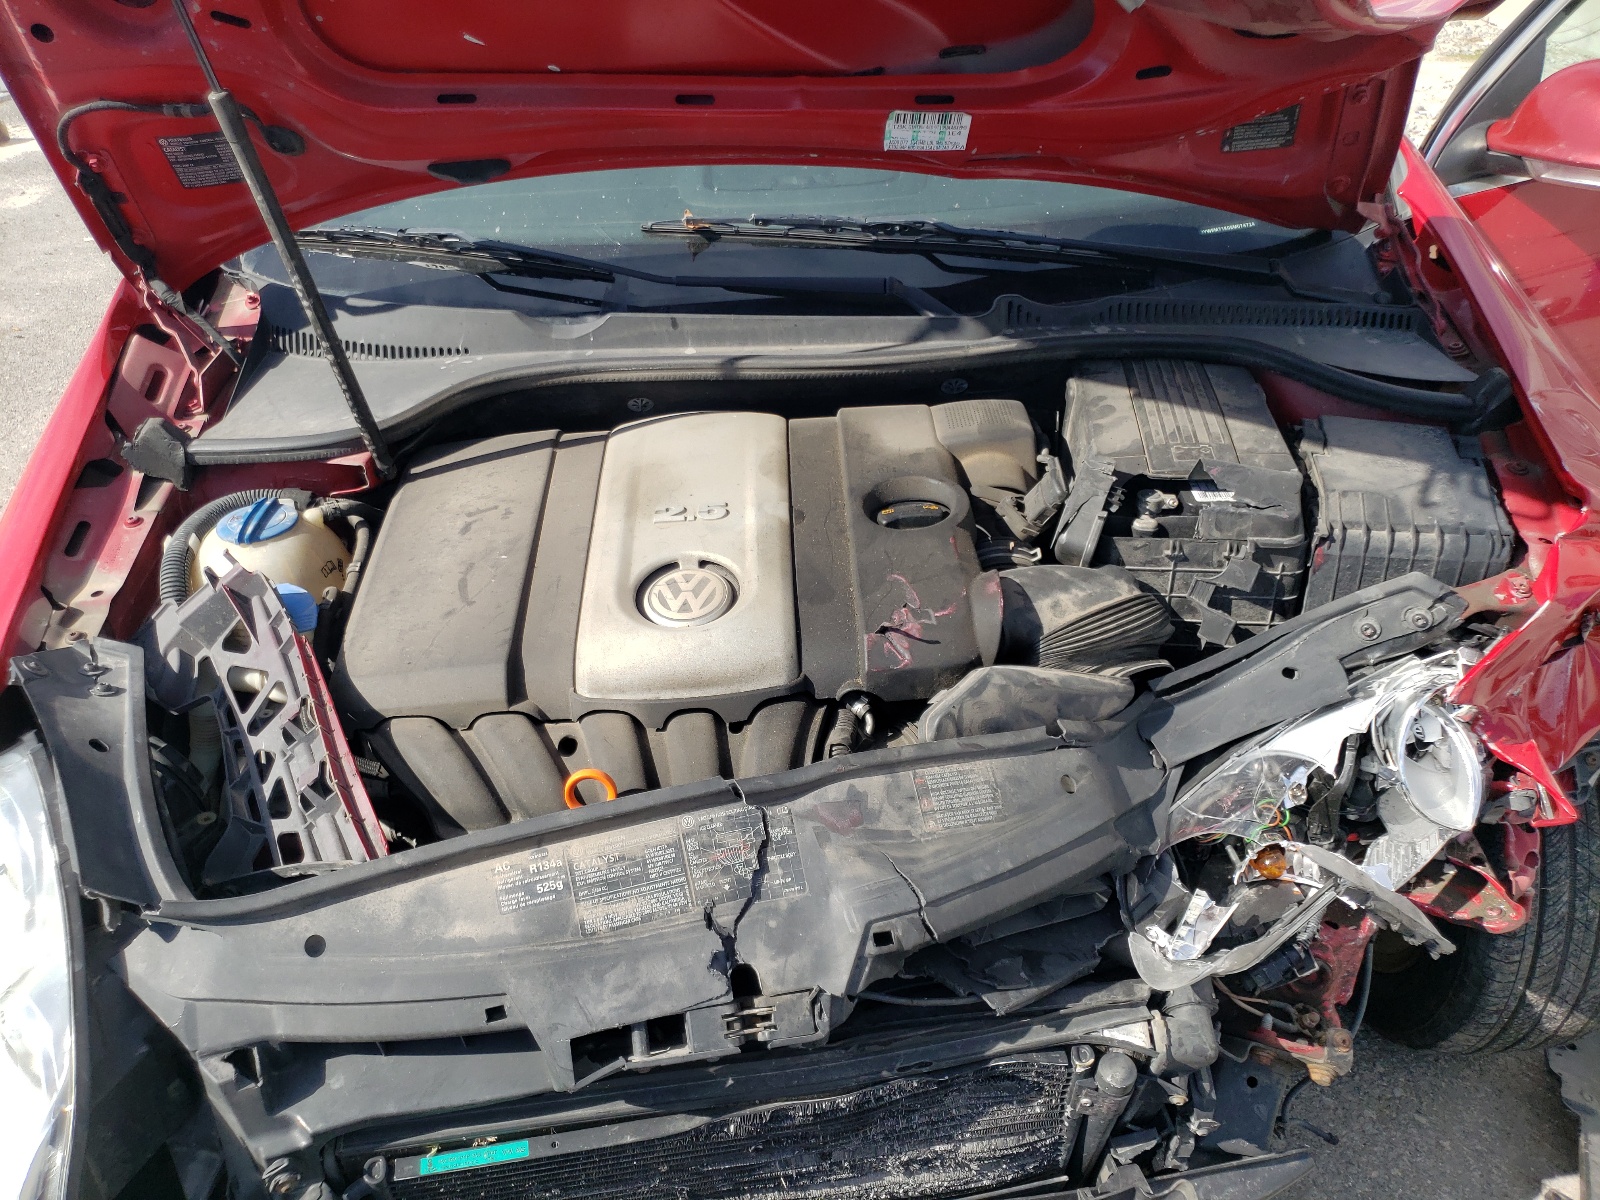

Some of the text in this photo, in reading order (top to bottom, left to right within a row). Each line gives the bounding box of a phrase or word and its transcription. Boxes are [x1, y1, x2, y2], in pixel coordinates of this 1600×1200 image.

[653, 502, 731, 524] 2.5
[494, 860, 511, 874] AC
[529, 858, 563, 875] R134a
[573, 852, 621, 871] CATALYST
[536, 880, 564, 895] 525g
